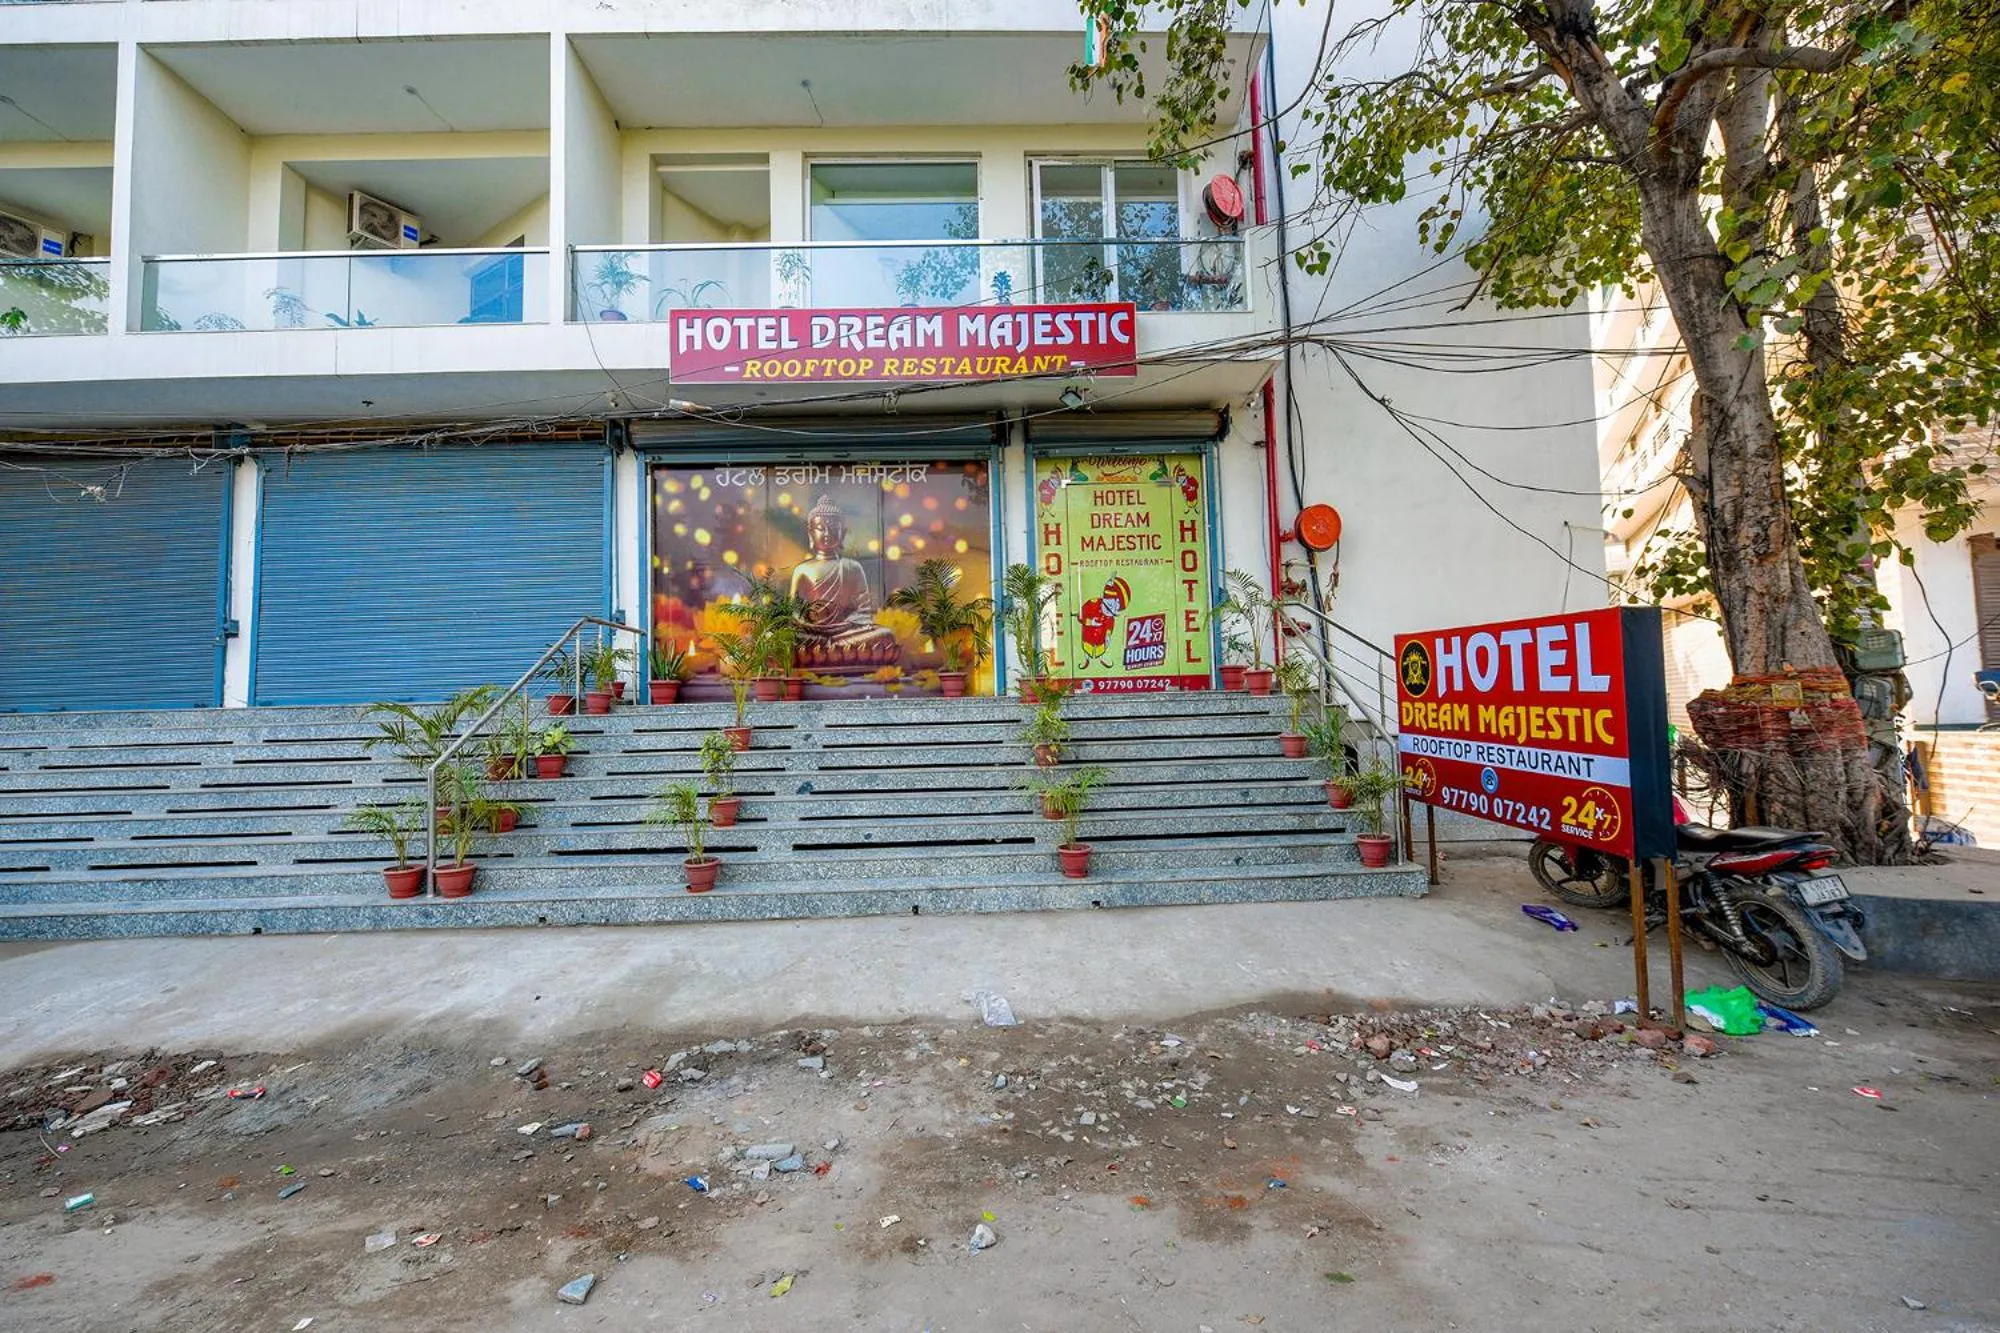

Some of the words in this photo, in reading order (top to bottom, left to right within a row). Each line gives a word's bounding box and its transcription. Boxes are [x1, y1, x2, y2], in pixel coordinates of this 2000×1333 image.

[677, 315, 799, 355] HOTEL
[810, 313, 943, 352] DREAM
[959, 311, 1130, 354] MAJESTIC
[742, 358, 874, 378] ROOFTOP
[881, 355, 1068, 377] RESTAURANT
[1094, 489, 1146, 507] HOTEL
[1090, 511, 1150, 529] DREAM
[1080, 534, 1162, 552] MAJESTIC
[1179, 519, 1201, 663] HOTEL
[1126, 645, 1165, 664] HOURS
[1435, 622, 1611, 698] HOTEL
[1098, 680, 1133, 690] 97790
[1401, 701, 1470, 732] DREAM
[1478, 704, 1614, 745] MAJESTIC
[1412, 737, 1471, 759] ROOFTOP
[1477, 745, 1595, 778] RESTAURANT
[1441, 786, 1489, 814] 97790
[1493, 795, 1552, 831] 07242
[1561, 823, 1594, 840] SERVICE
